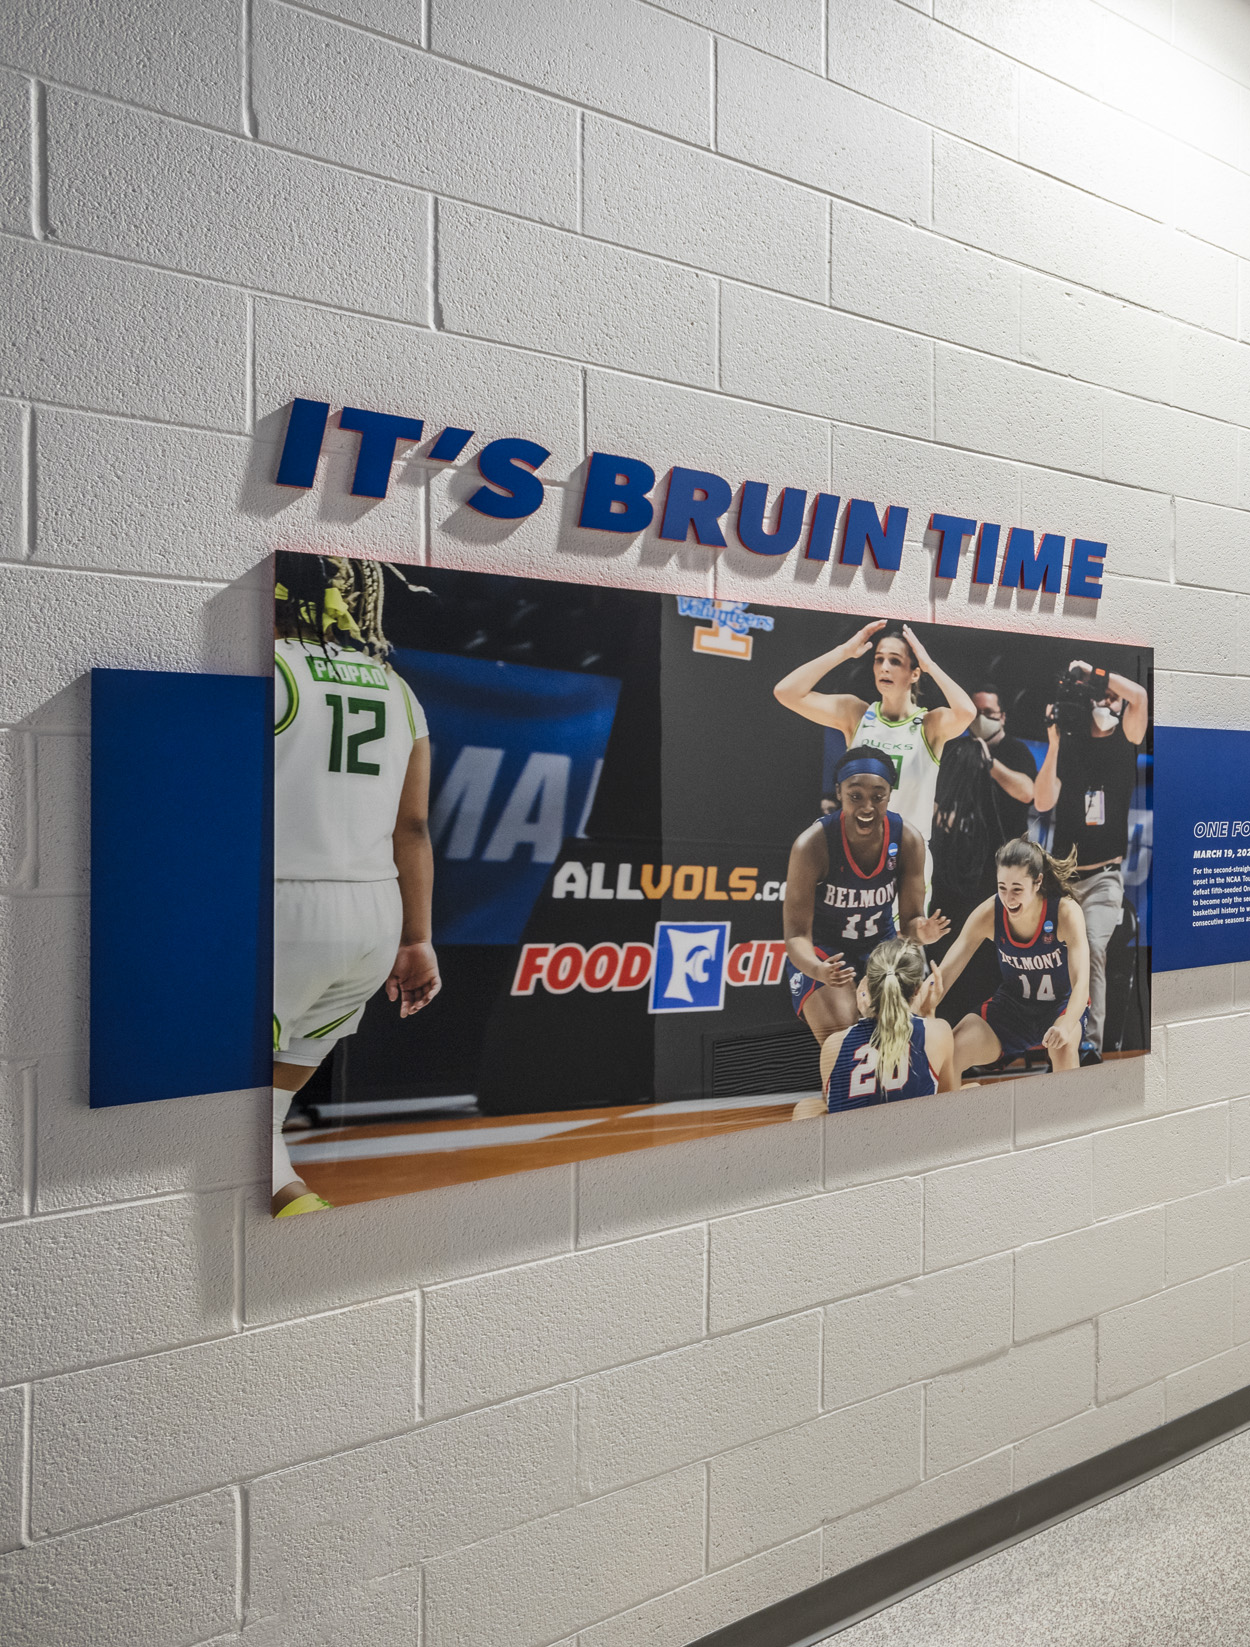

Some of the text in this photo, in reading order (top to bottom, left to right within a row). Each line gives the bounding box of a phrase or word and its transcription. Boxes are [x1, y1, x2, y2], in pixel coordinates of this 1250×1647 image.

[578, 451, 909, 571] BRUIN
[928, 512, 1108, 600] TIME
[325, 693, 386, 776] 12
[1193, 821, 1229, 838] ONE
[1193, 850, 1222, 858] MARCH
[1224, 849, 1235, 858] 19,
[552, 861, 787, 901] ALLVOLS.c
[824, 880, 897, 908] BELMON
[1193, 878, 1208, 886] upset
[1192, 919, 1223, 927] consecutive
[1193, 908, 1220, 916] basketball
[511, 942, 653, 995] FOOD
[725, 940, 788, 986] CIT
[1018, 973, 1056, 1001] 14
